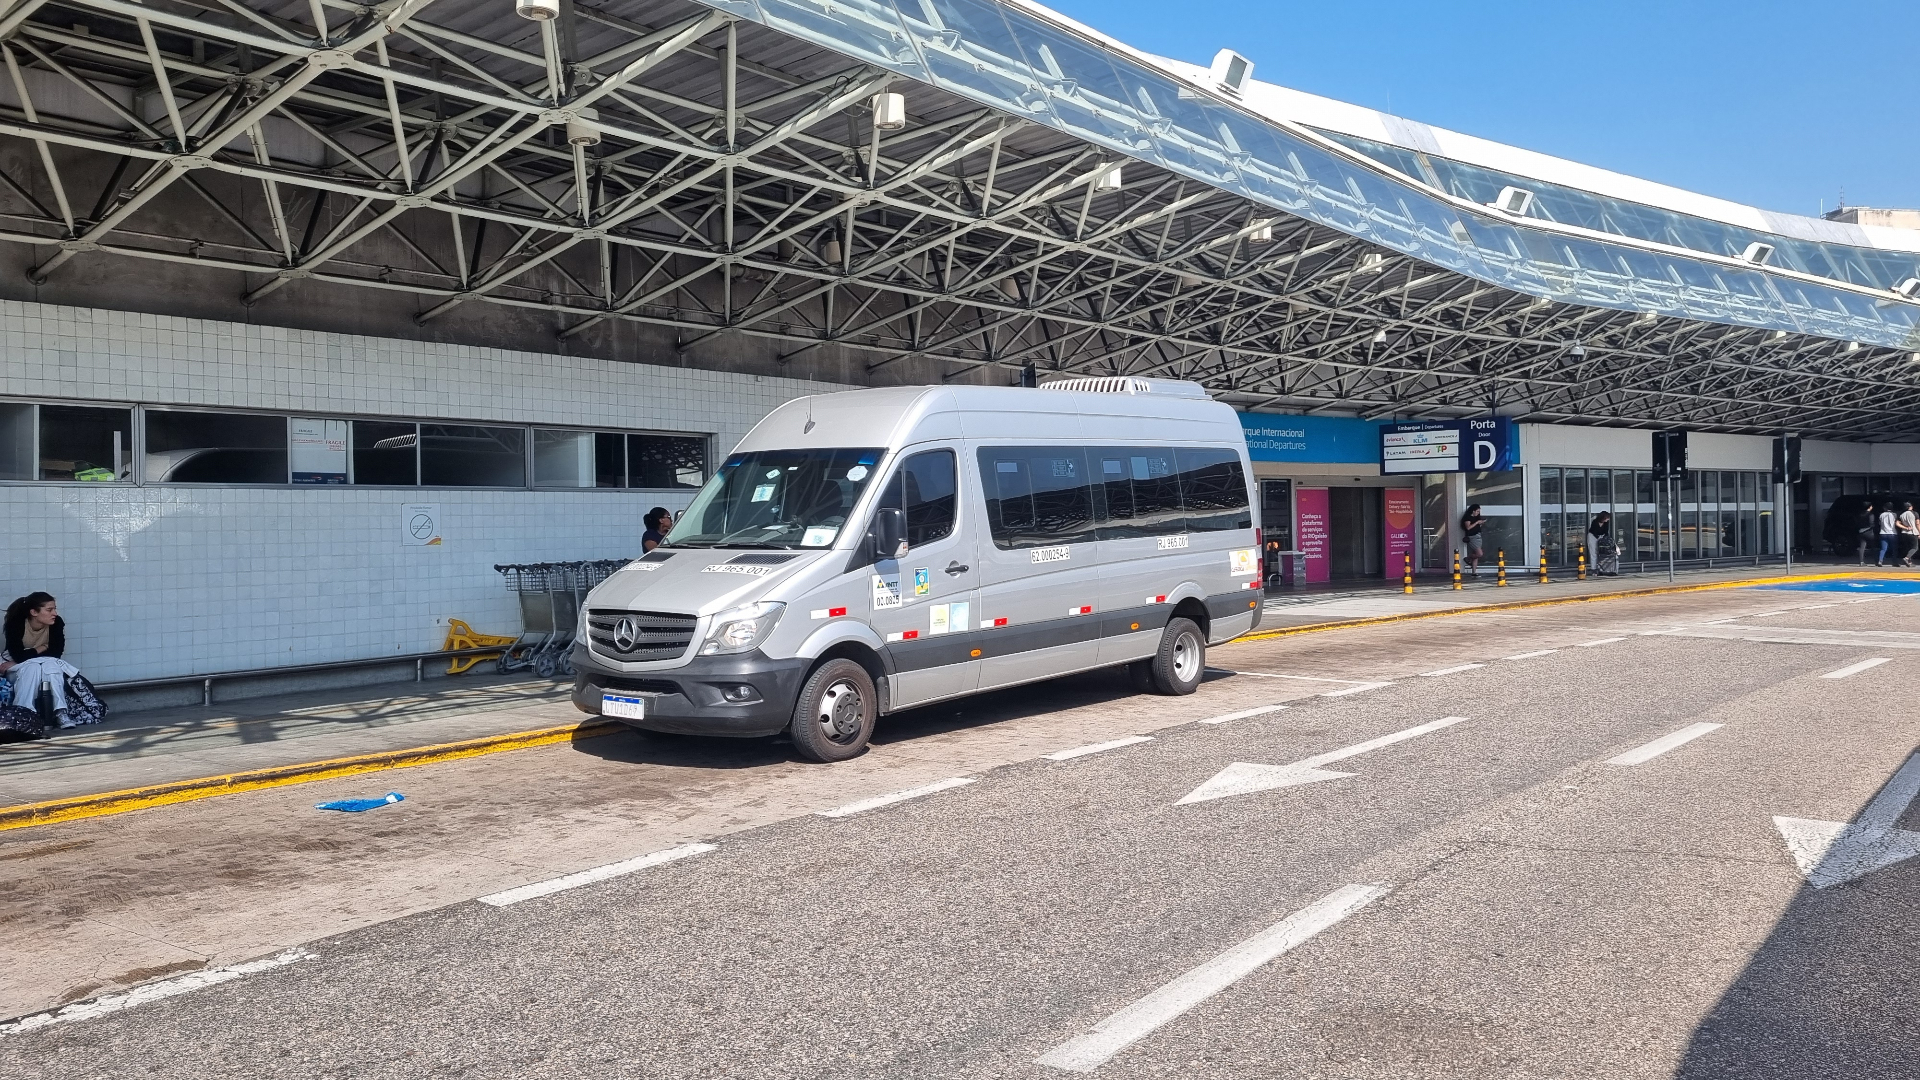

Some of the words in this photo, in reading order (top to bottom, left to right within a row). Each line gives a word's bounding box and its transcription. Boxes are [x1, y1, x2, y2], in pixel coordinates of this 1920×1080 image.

[1470, 420, 1496, 430] Porta
[1262, 427, 1304, 438] Internacional
[1270, 440, 1306, 451] Departures
[1474, 440, 1497, 469] D
[1157, 539, 1166, 549] RJ
[1166, 537, 1188, 548] 965.001
[722, 566, 771, 576] 965.001
